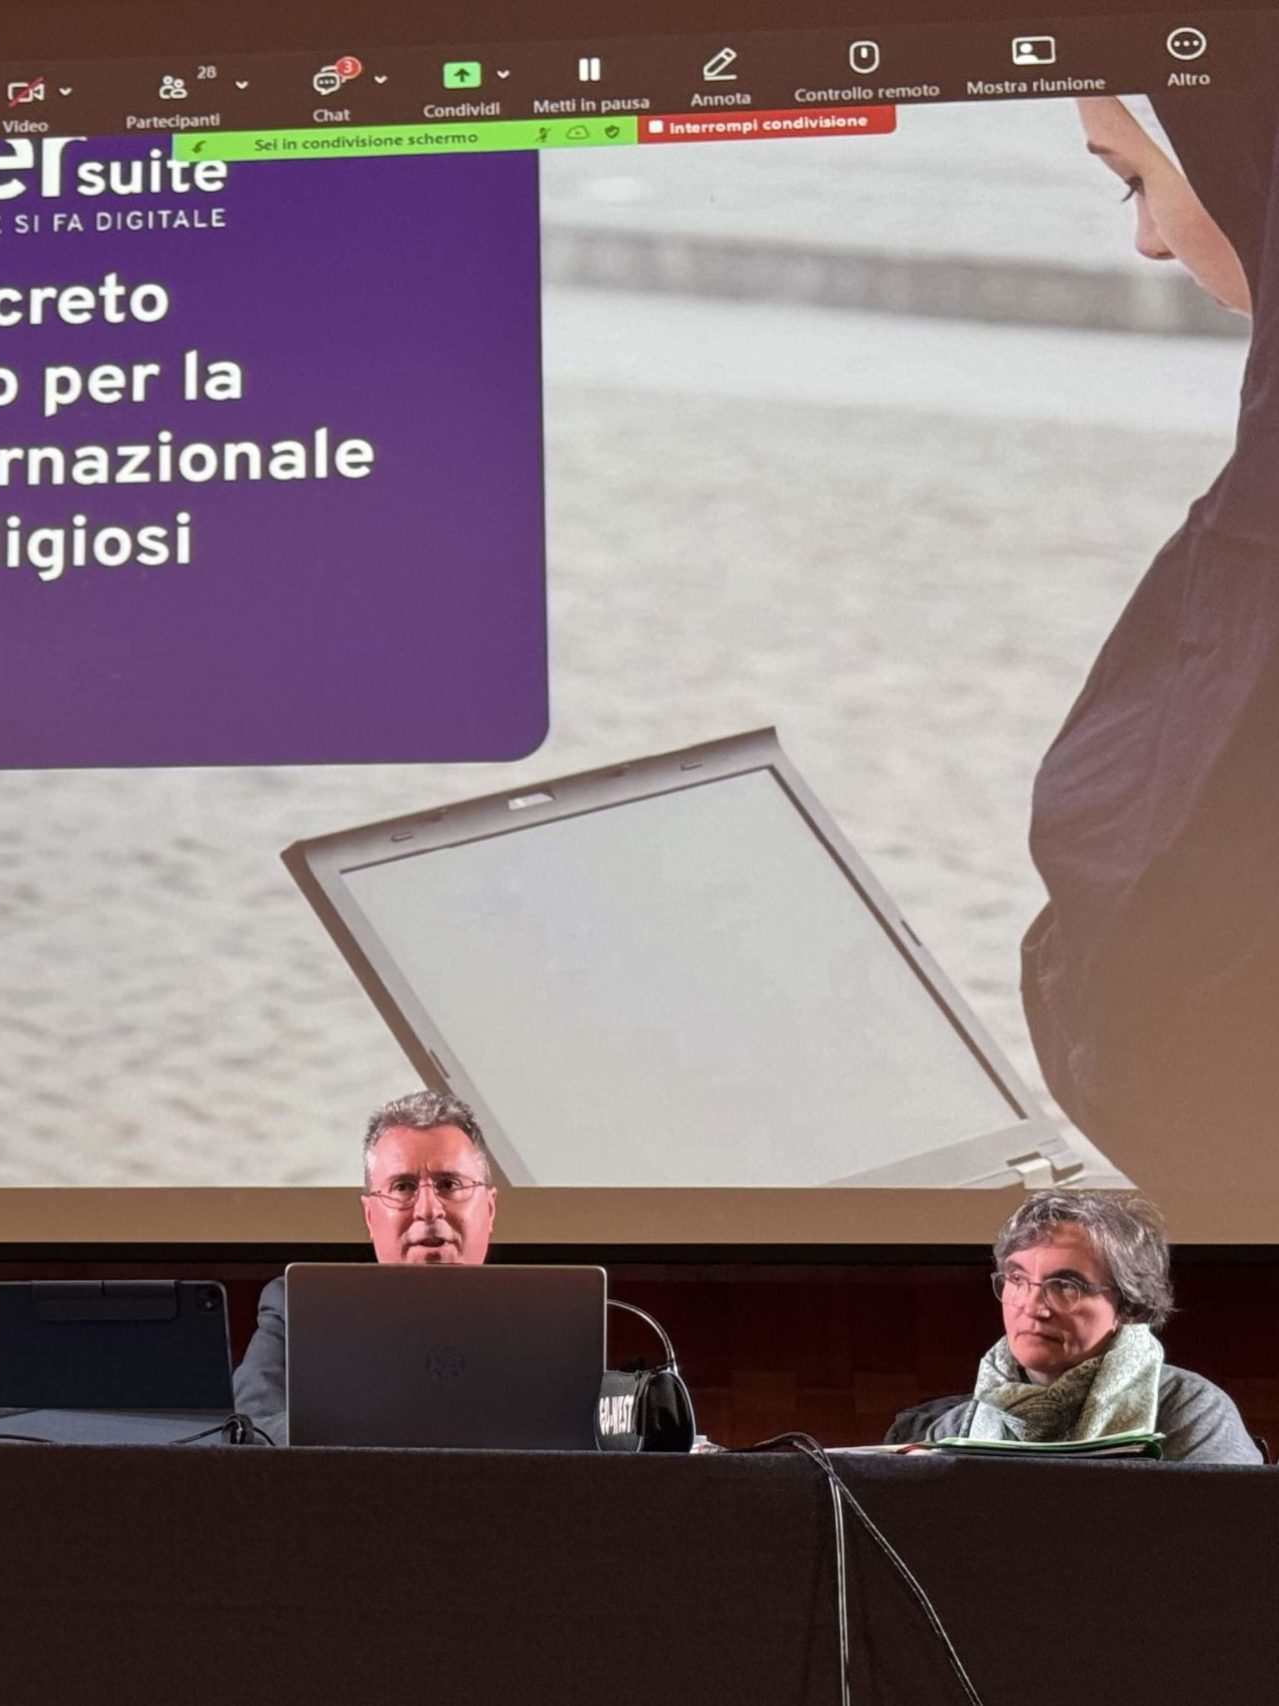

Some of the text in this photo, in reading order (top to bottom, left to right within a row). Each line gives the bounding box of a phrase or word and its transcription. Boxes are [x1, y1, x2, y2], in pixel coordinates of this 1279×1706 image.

[197, 65, 217, 80] 28
[1167, 72, 1211, 87] Altro
[794, 84, 940, 102] Controllo remoto
[966, 77, 1106, 95] Mostra riunione
[533, 97, 651, 114] Metti in pausa
[690, 92, 752, 107] Annota
[312, 108, 350, 123] Chat
[423, 101, 501, 118] Condividi
[2, 119, 49, 133] Video
[126, 113, 221, 130] Partecipanti
[669, 113, 869, 135] Interrompi condivisione
[254, 132, 479, 152] Sei in condivisione schermo
[14, 214, 39, 234] SI
[53, 213, 84, 232] FA
[96, 207, 226, 232] DIGITALE
[44, 363, 161, 417] per
[185, 349, 242, 401] la
